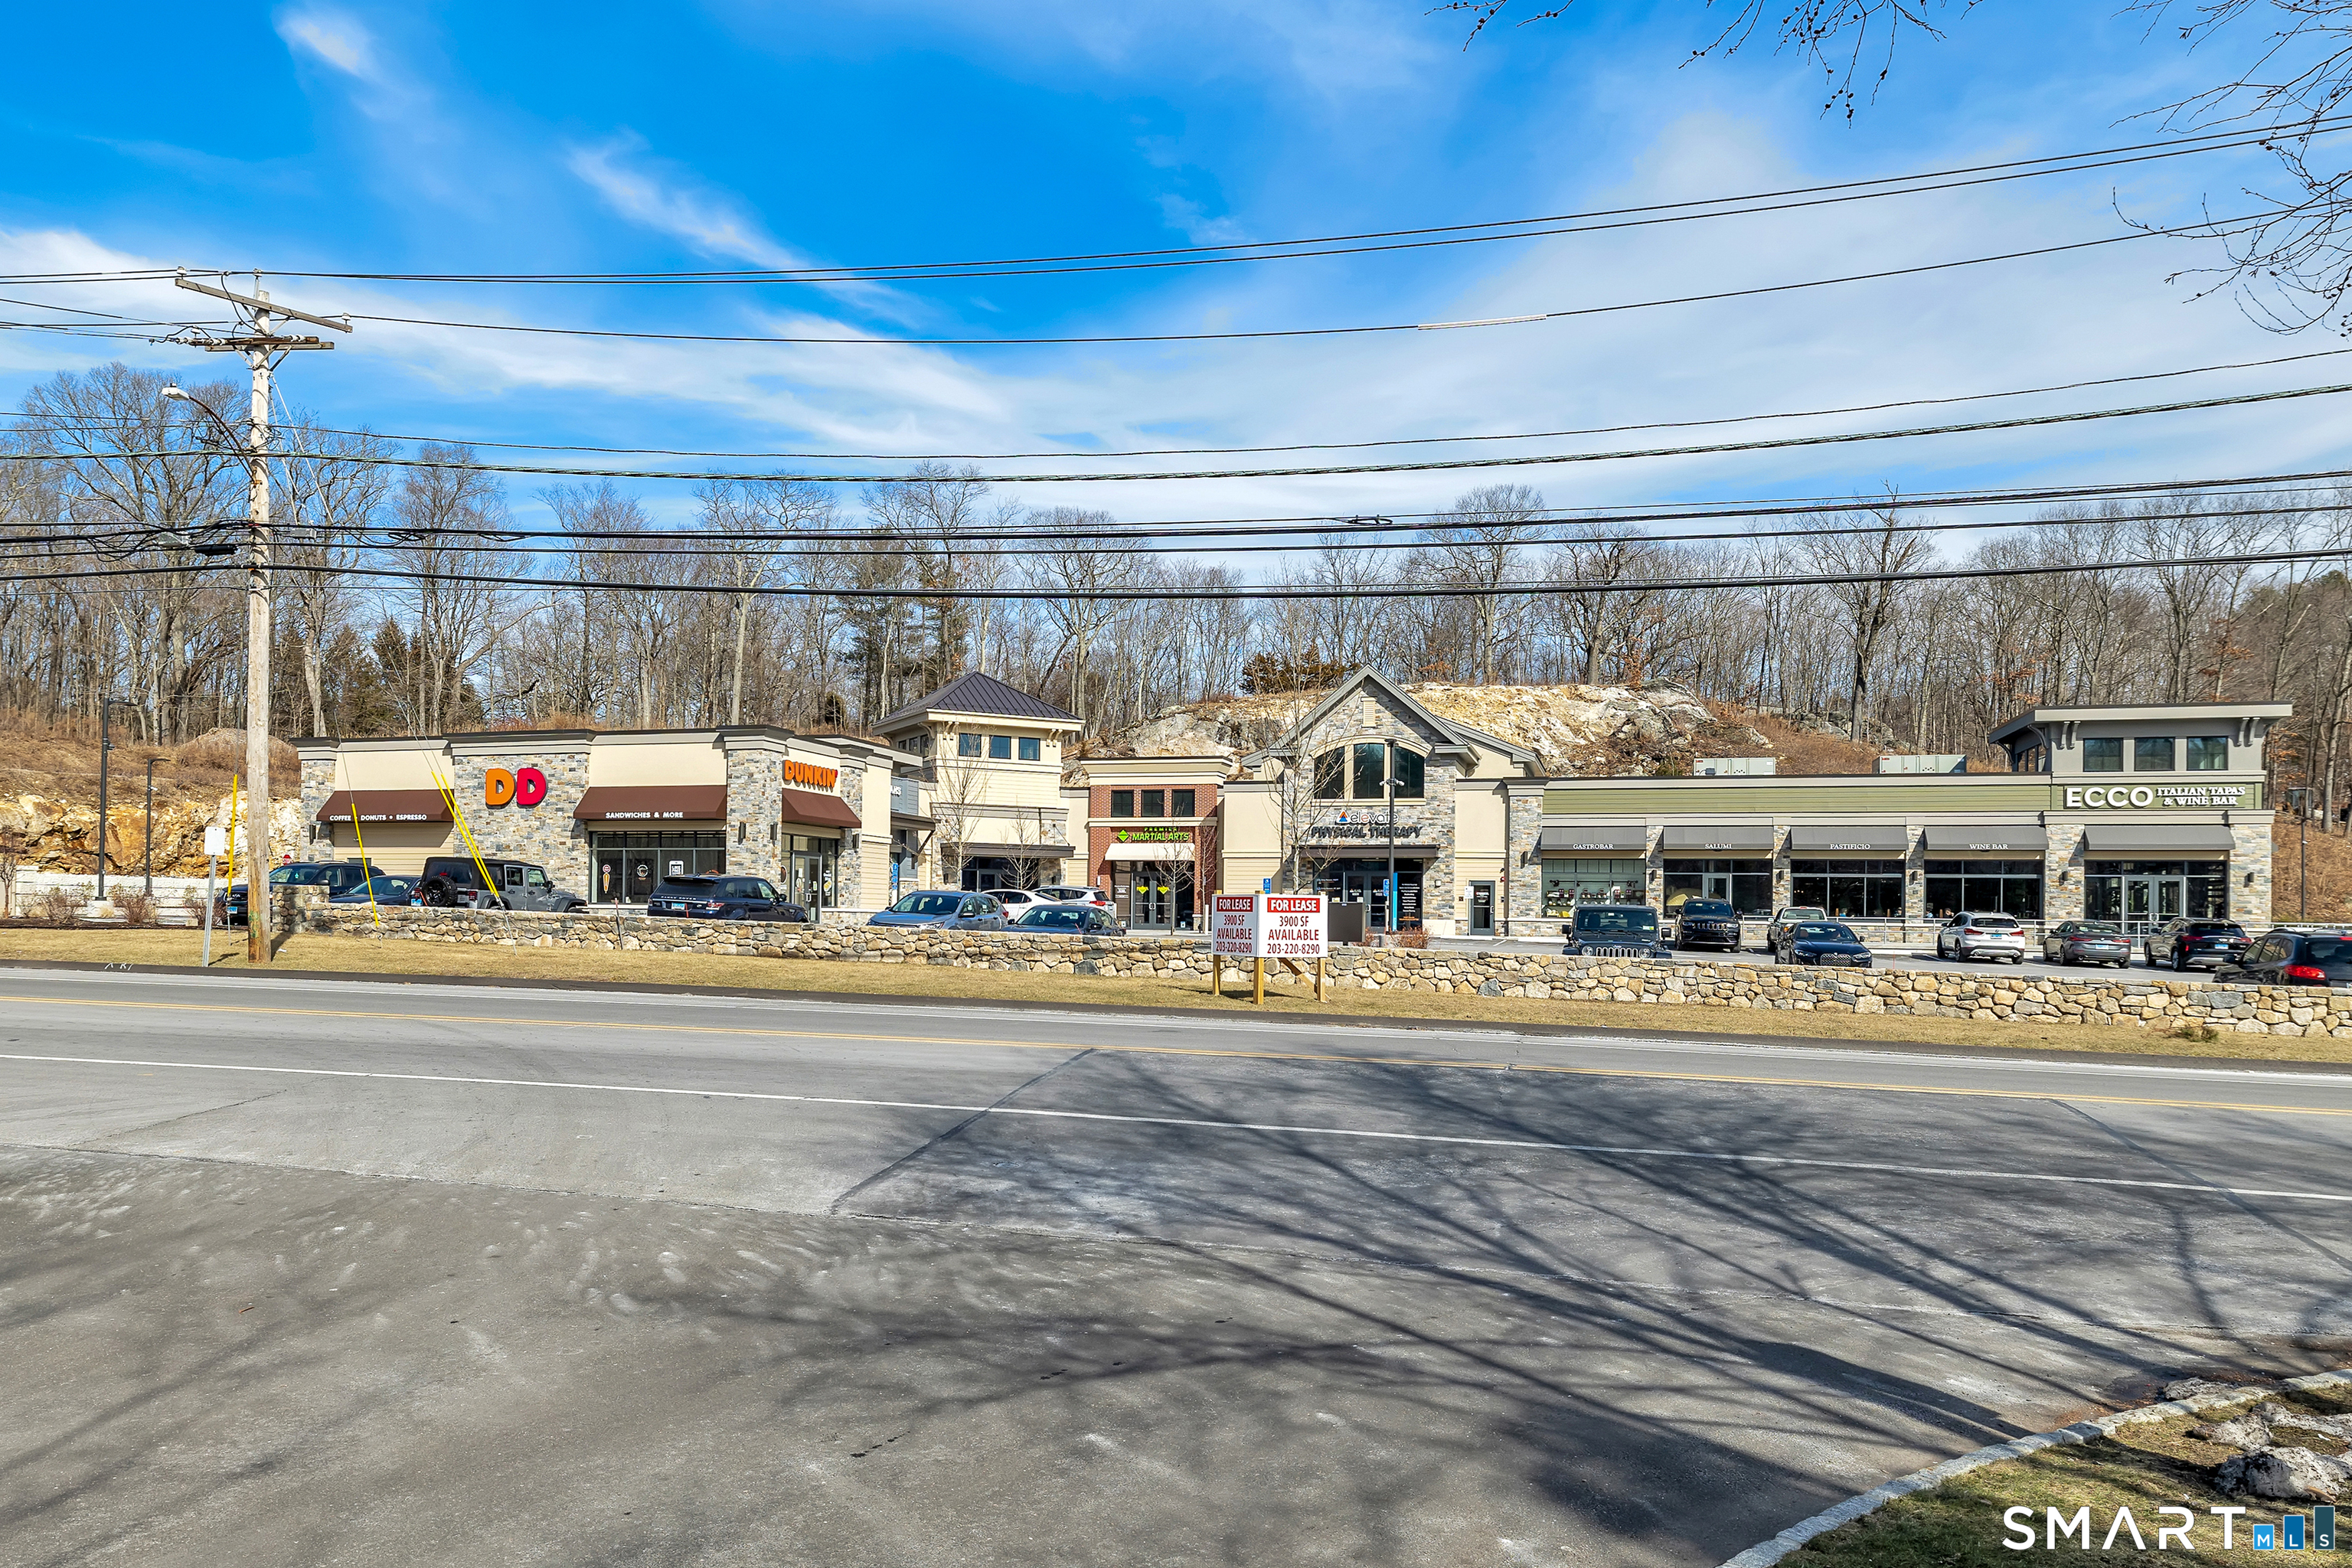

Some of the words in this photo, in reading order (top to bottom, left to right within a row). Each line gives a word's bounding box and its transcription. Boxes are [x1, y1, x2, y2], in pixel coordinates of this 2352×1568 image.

[782, 760, 838, 788] DUNKIN'
[485, 768, 547, 808] DD
[2156, 787, 2207, 796] ITALIAN
[2208, 786, 2246, 796] TAPAS
[2065, 787, 2154, 808] ECCO
[2163, 797, 2173, 805] &
[2174, 797, 2209, 805] WINE
[2210, 796, 2239, 805] BAR
[1351, 812, 1399, 824] elevate
[1132, 832, 1166, 841] MARTIAL
[1168, 832, 1189, 841] ARTS
[1312, 827, 1367, 838] PHYSICAL
[1368, 827, 1423, 838] THERAPY
[1219, 899, 1230, 910] FOR
[1231, 899, 1251, 910] LEASE
[1270, 900, 1289, 911] FOR
[1291, 900, 1317, 911] LEASE
[1223, 914, 1236, 926] 3900
[1238, 915, 1245, 926] SF
[1279, 916, 1298, 927] 3900
[1300, 916, 1309, 926] SF
[1217, 928, 1253, 940] AVAILABLE
[1268, 929, 1319, 940] AVAILABLE
[1216, 941, 1253, 953] 203-220-8290
[1267, 943, 1320, 954] 203-220-8290
